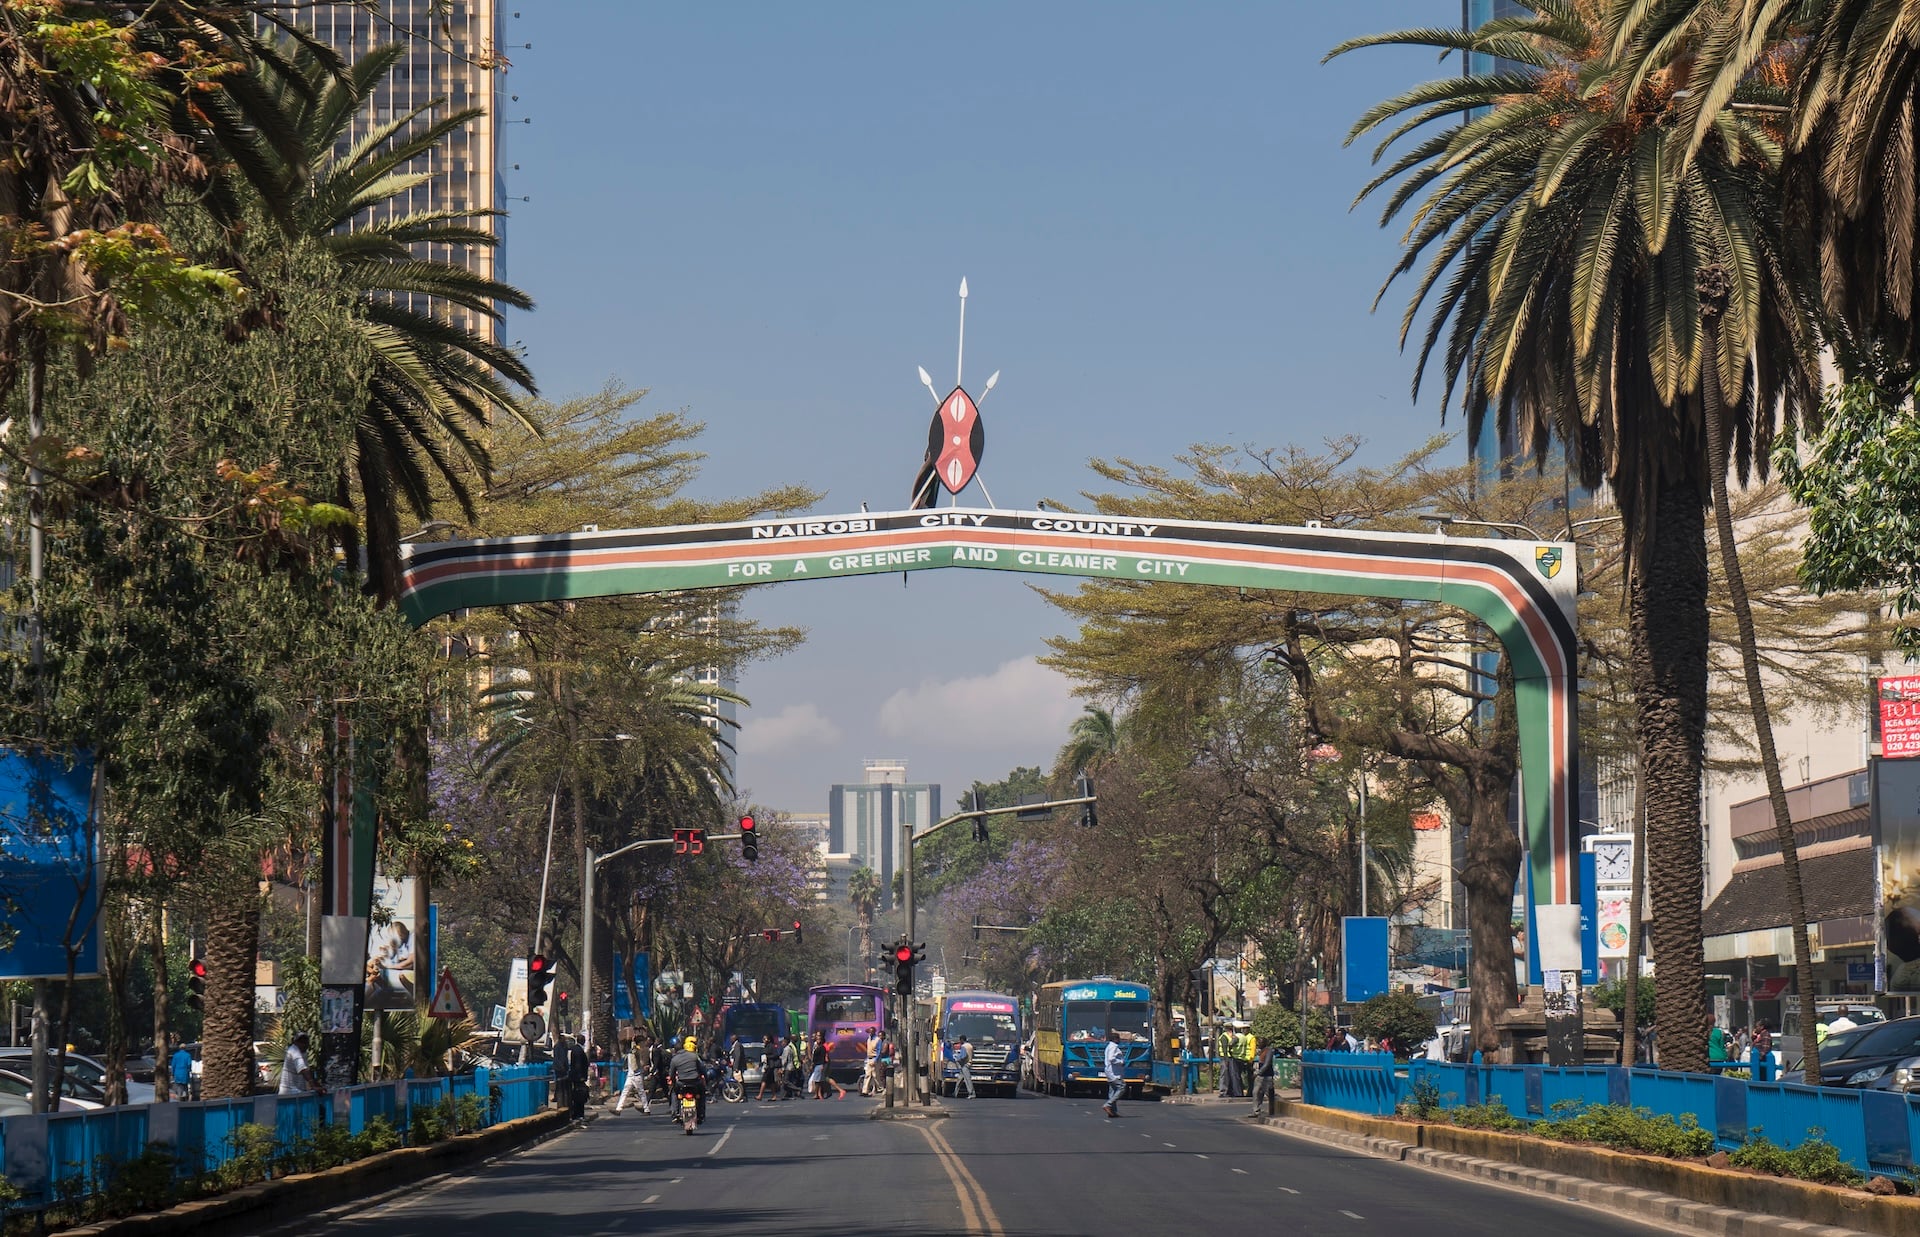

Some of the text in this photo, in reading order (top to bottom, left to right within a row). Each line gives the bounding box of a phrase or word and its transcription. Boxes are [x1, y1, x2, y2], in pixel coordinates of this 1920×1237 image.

[752, 514, 1158, 538] NAIROBI CITY COUNTY
[728, 547, 1190, 577] FOR A GREENER AND CLEANER CITY
[1884, 703, 1906, 717] TO
[1887, 742, 1903, 750] 020
